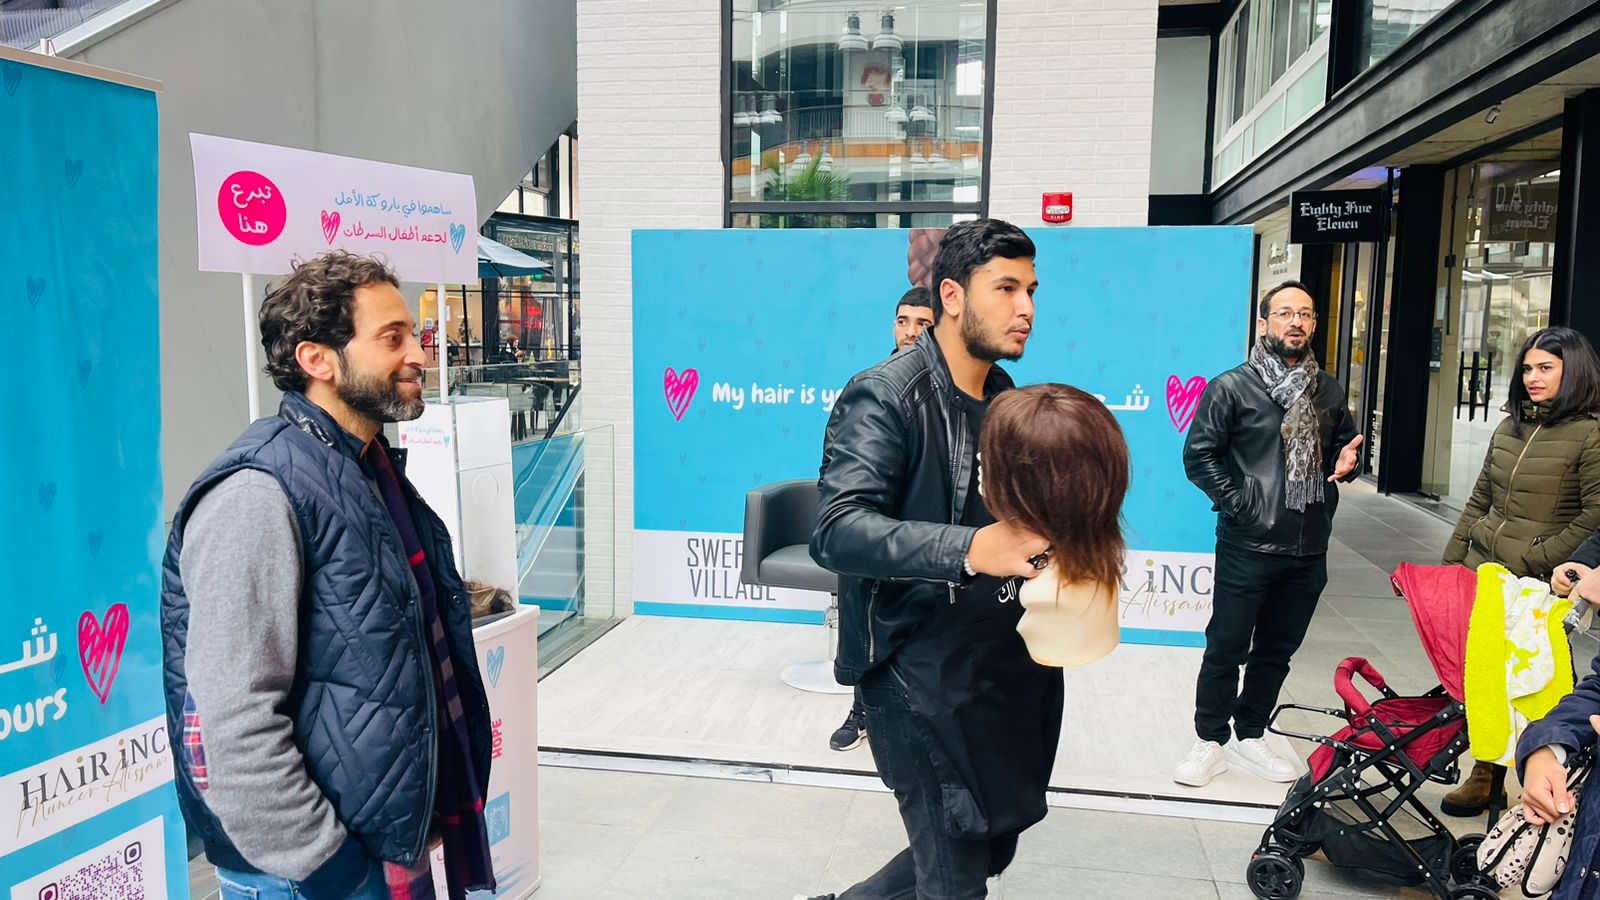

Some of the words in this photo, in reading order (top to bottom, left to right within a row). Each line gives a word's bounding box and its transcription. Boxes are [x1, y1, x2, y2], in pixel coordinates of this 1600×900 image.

[230, 183, 272, 209] تبرع
[335, 188, 364, 207] الأمل
[402, 199, 417, 218] في
[418, 200, 452, 216] ساهموا
[1300, 202, 1342, 218] Eighty
[1343, 201, 1373, 216] Five
[238, 213, 268, 234] هنا
[343, 221, 387, 240] السرطان
[388, 224, 419, 242] أطفال
[1316, 217, 1359, 232] Eleven
[421, 231, 448, 243] لدعم
[712, 382, 745, 410] My
[751, 382, 796, 404] hair
[801, 384, 816, 404] is
[492, 718, 503, 760] HOPE
